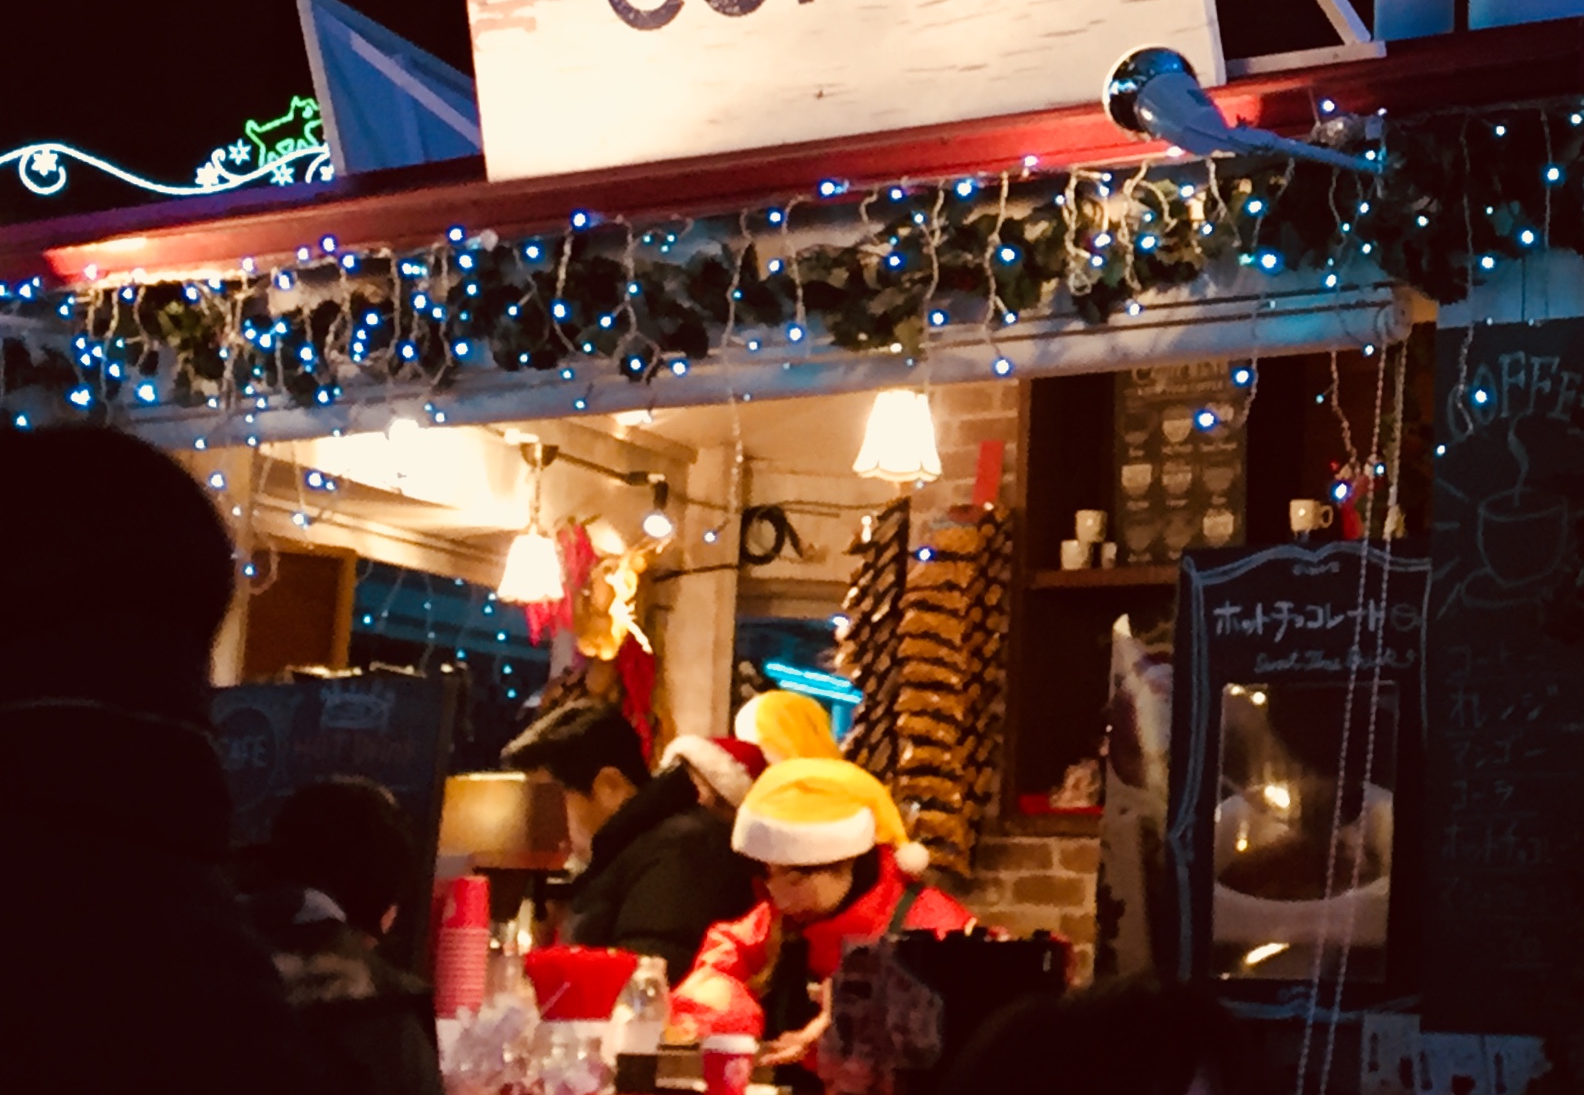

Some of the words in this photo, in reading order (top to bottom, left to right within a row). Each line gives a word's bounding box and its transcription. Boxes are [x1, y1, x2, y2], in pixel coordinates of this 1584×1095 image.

[1213, 593, 1385, 643] ホットチョコレート
